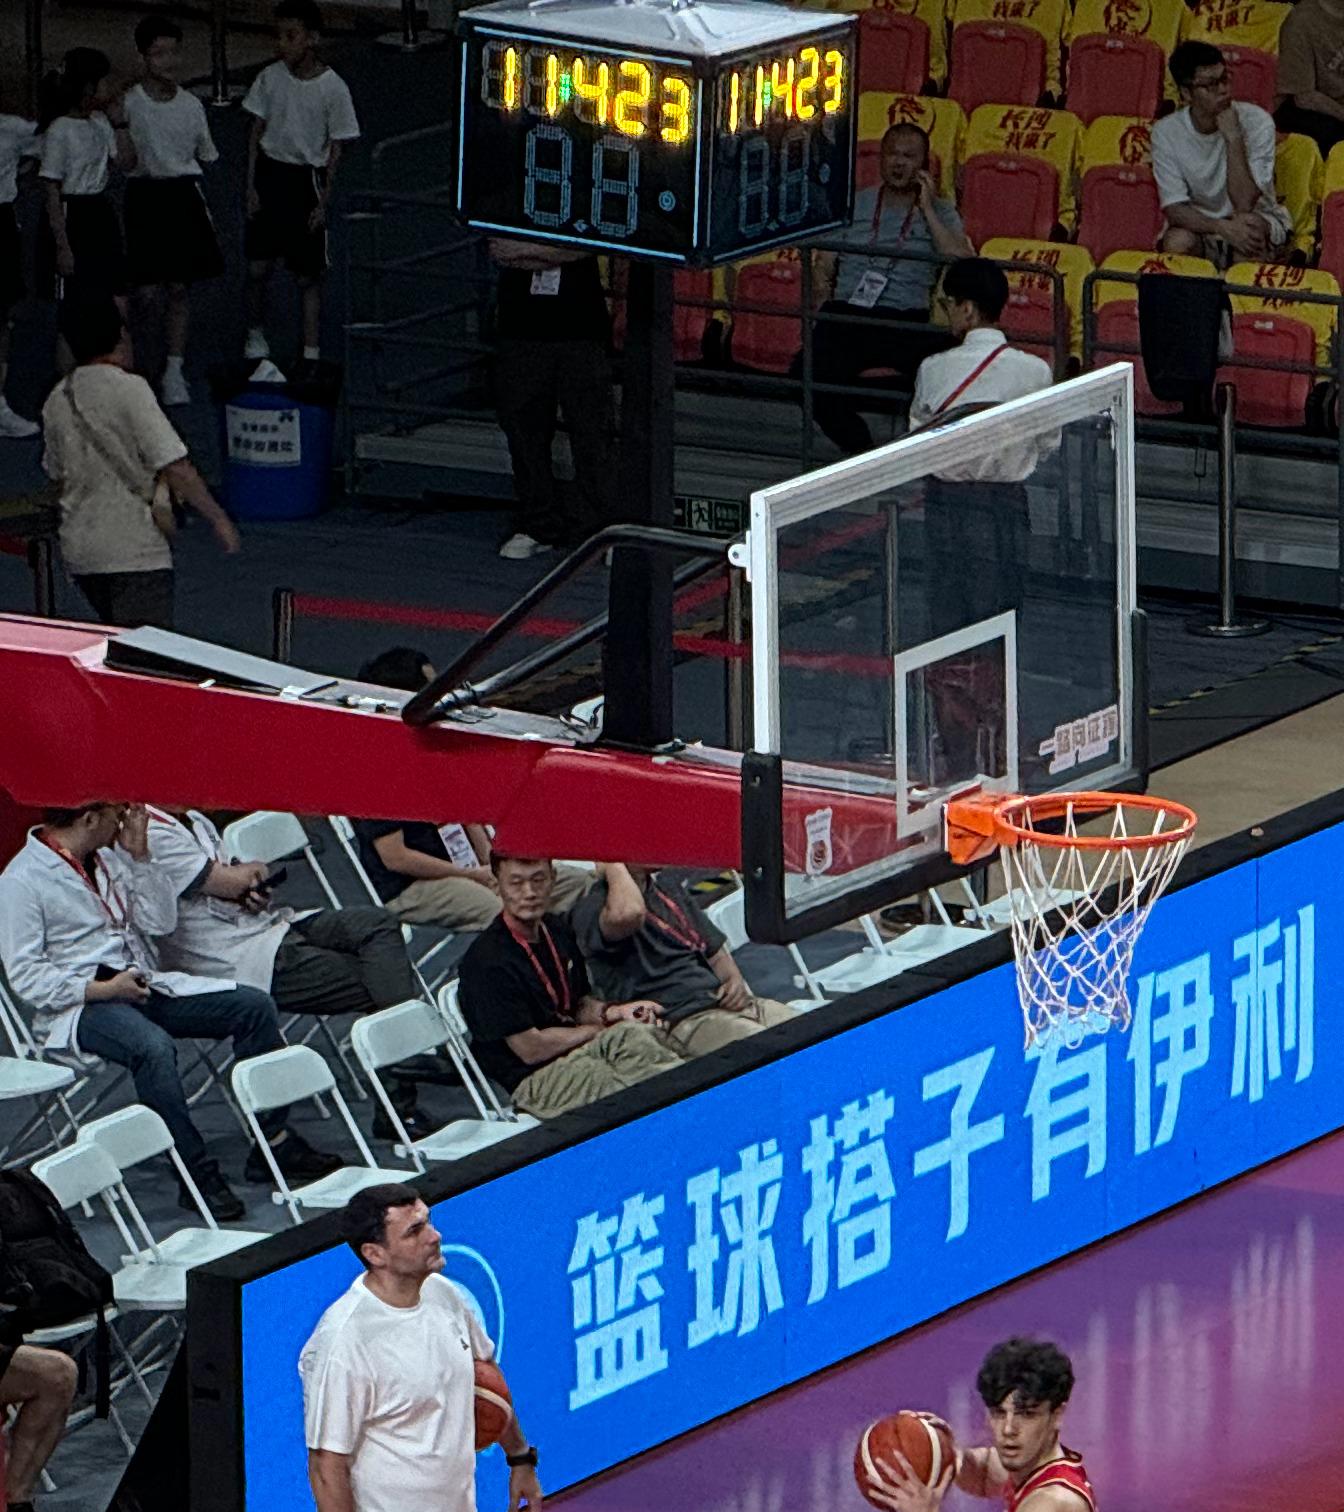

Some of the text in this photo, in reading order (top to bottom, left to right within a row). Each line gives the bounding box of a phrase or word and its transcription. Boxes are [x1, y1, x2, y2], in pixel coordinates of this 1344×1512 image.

[566, 903, 1318, 1412] 篮球搭子有伊利
